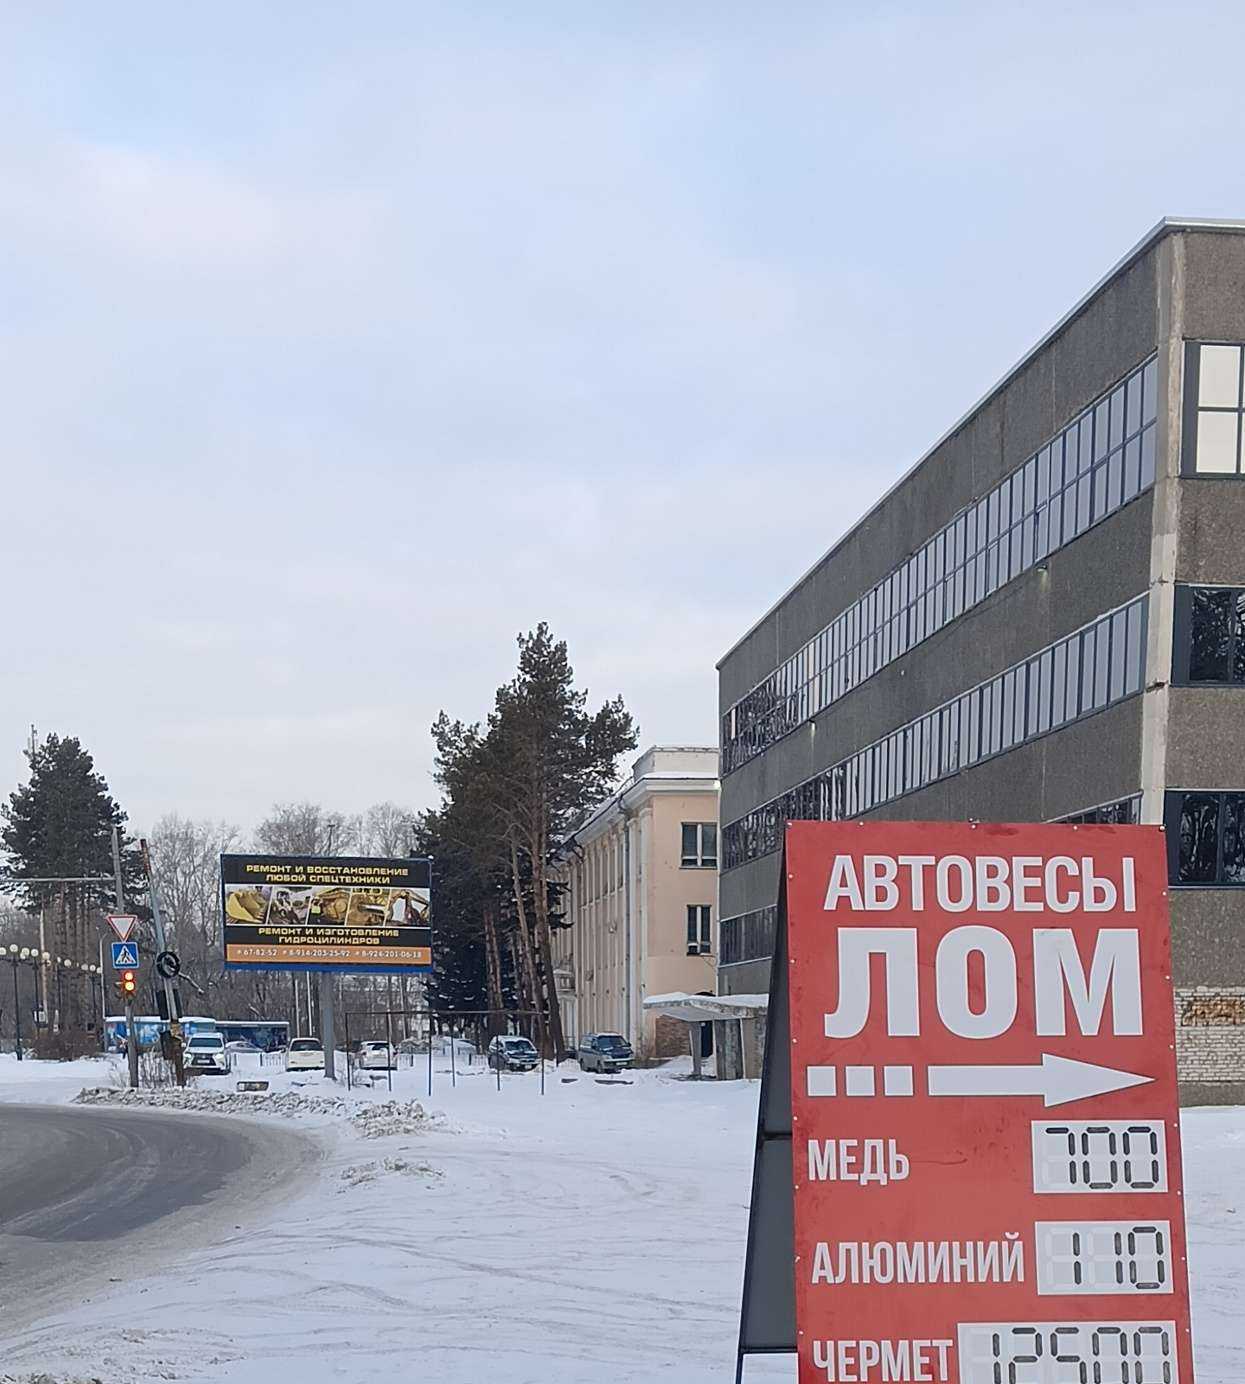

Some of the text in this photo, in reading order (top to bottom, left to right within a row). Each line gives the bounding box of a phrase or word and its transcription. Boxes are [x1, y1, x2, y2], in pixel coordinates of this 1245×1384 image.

[247, 865, 408, 876] РЕМОНТ И ВОССТАНОВЛЕНИЕ
[266, 874, 390, 884] ЛЮБОЙ СПЕЦТЕХНИКИ
[823, 855, 1137, 913] АВТОВЕСЫ
[279, 936, 379, 945] ГИДРОЦИЛИНДРОВ
[317, 928, 399, 937] ИЗГОТОВЛЕНИЕ
[823, 925, 1144, 1040] ЛОМ
[807, 1139, 910, 1185] МЕДЬ
[1044, 1126, 1160, 1189] 700
[811, 1231, 1025, 1284] АЛЮМИНИЙ
[1072, 1226, 1166, 1289] 110
[812, 1339, 953, 1382] ЧЕРМЕТ
